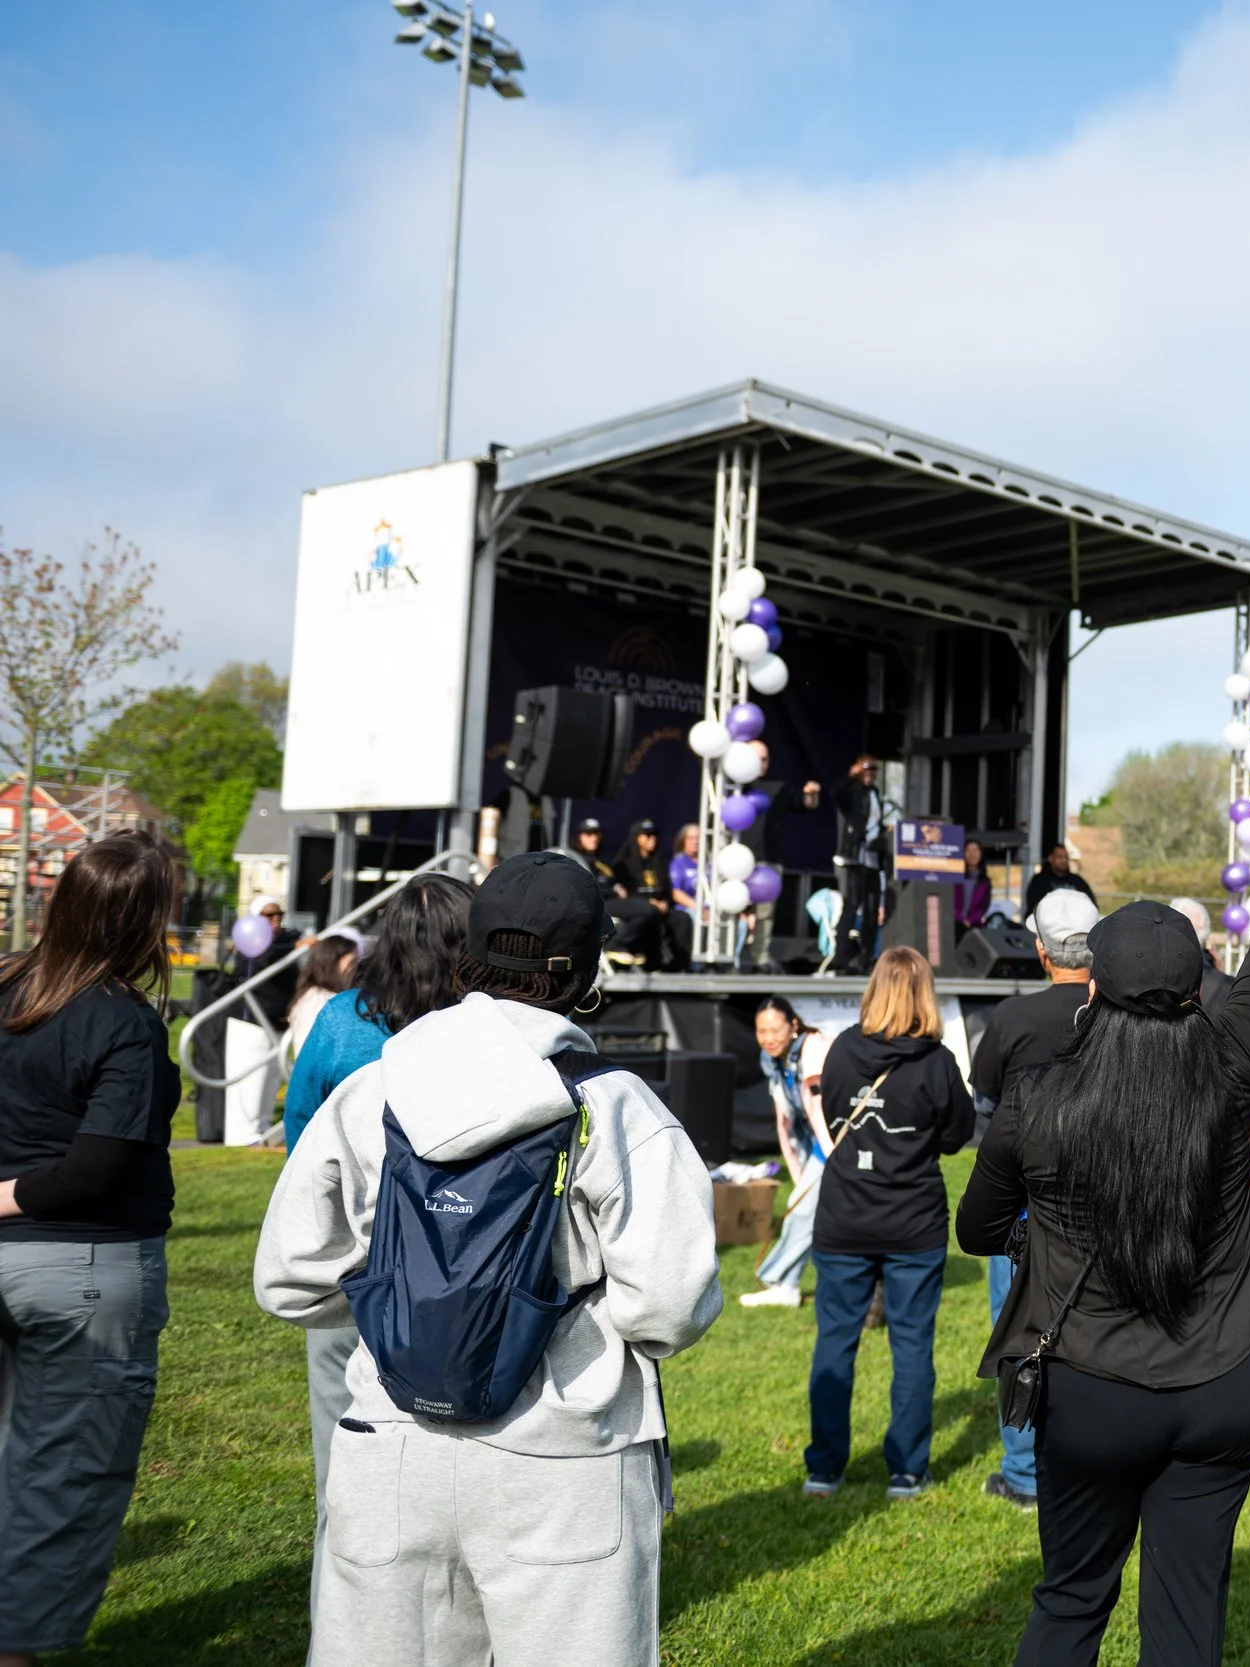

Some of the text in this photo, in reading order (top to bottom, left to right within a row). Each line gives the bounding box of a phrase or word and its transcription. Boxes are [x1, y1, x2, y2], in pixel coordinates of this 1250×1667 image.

[574, 664, 624, 686] LOUIS
[413, 1403, 456, 1416] ULTRALIGHT
[414, 1397, 453, 1409] STOWAWAY
